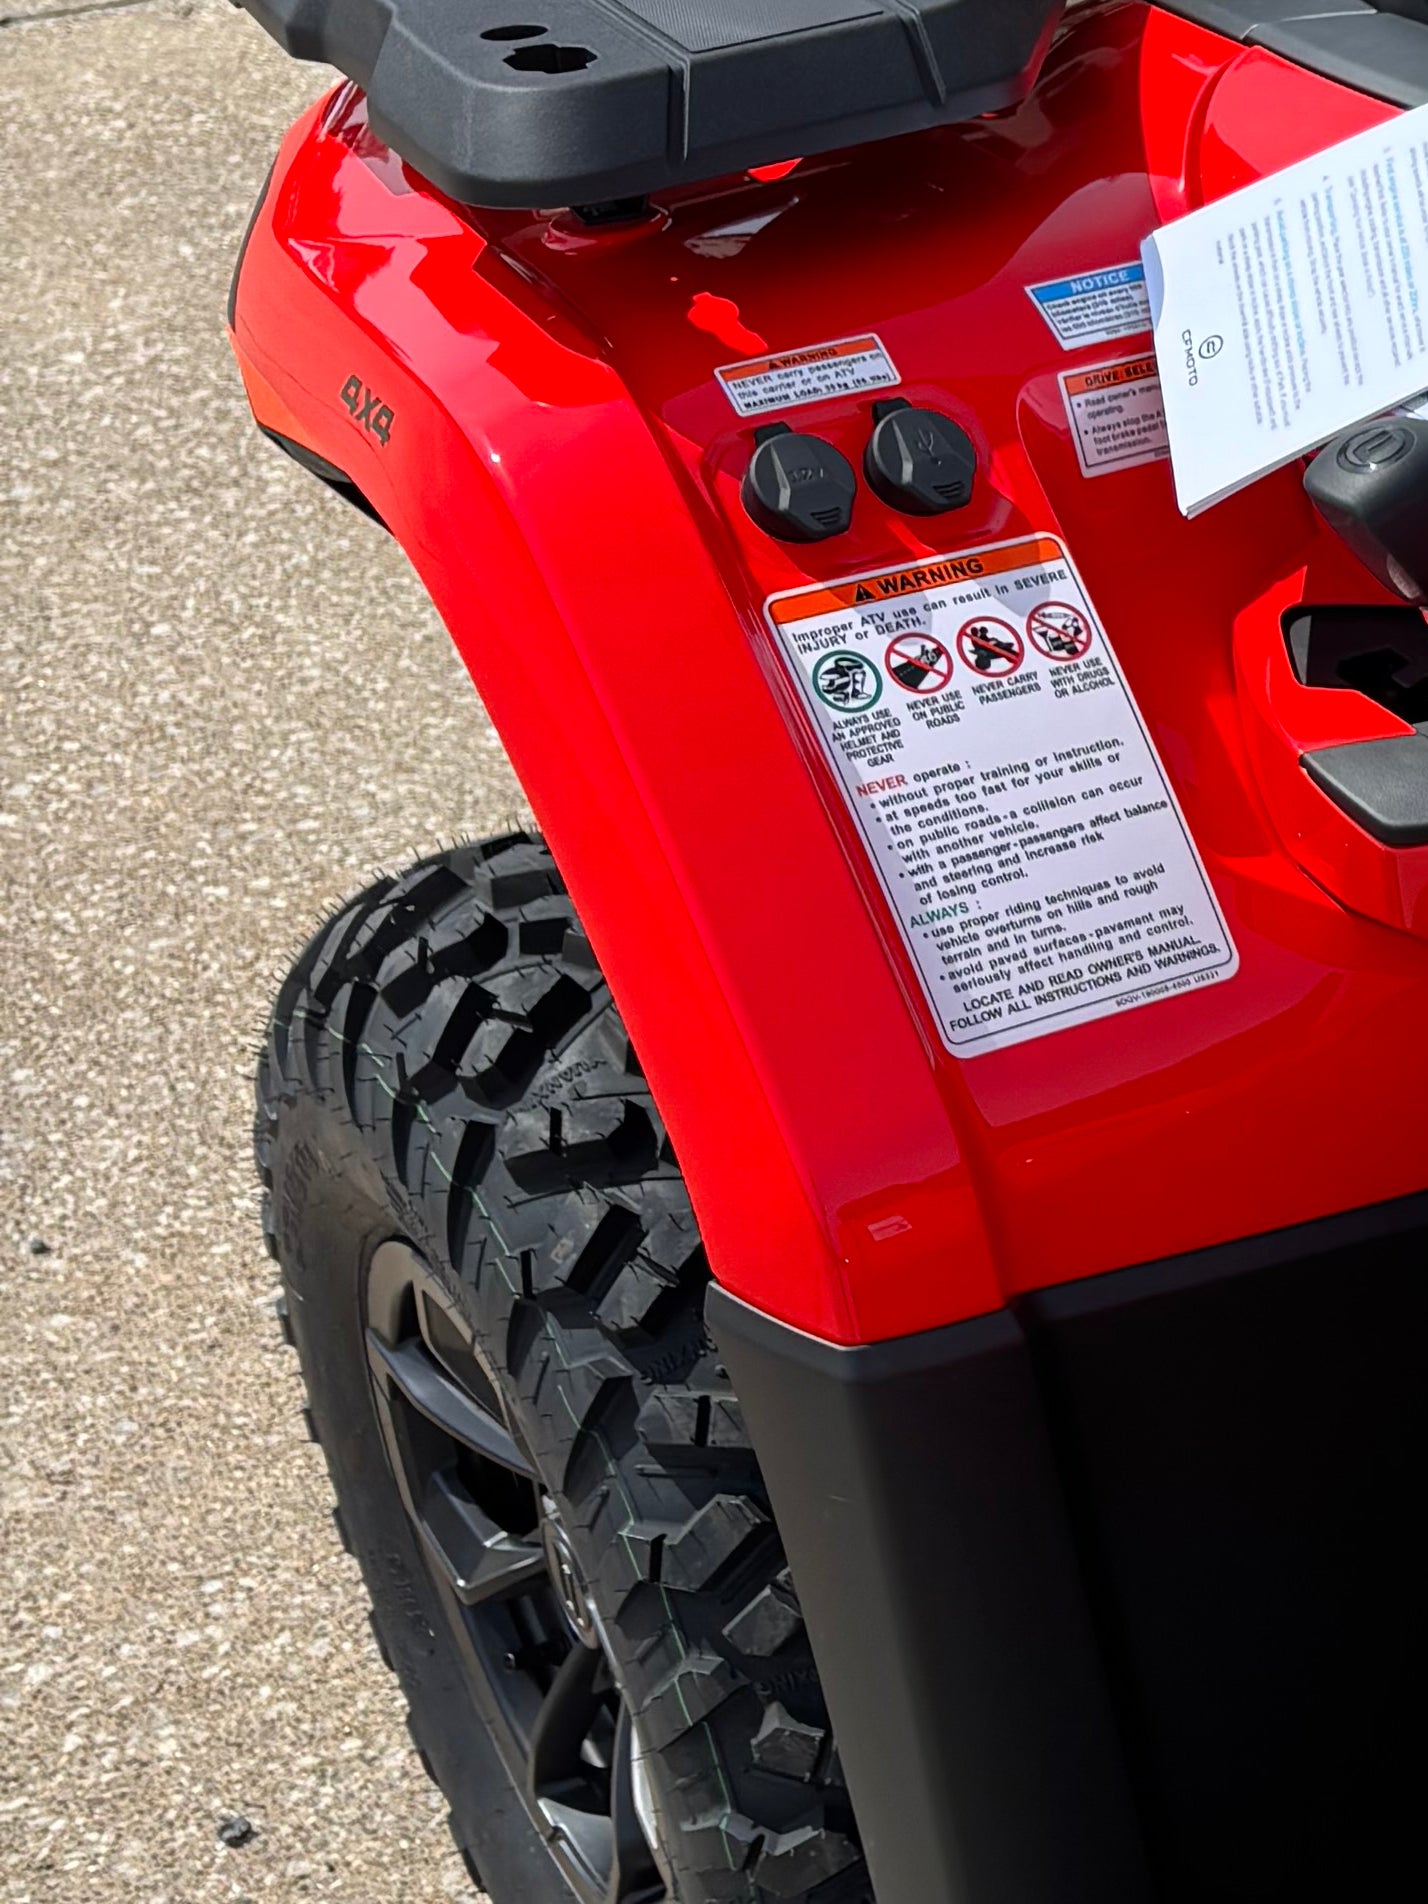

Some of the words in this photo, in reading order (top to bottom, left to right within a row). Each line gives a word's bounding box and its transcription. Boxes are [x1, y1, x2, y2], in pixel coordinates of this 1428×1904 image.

[1067, 269, 1131, 293] NOTICE
[731, 374, 772, 390] NEVER
[775, 367, 805, 381] carry
[806, 353, 868, 375] passengers
[779, 347, 838, 367] WARNING
[1182, 329, 1198, 386] CFMOTO
[1083, 369, 1119, 386] DRIVE
[877, 556, 985, 596] WARNING
[791, 619, 856, 645] Improper
[858, 611, 888, 629] ATV
[891, 604, 918, 621] use
[921, 596, 948, 614] can
[951, 586, 992, 606] result
[1012, 567, 1068, 591] SEVERE
[796, 633, 849, 656] INJURY
[874, 614, 927, 637] DEATH.
[971, 679, 1006, 696] NEVER
[1005, 670, 1040, 687] CARRY
[1048, 661, 1081, 678] NEVER
[1081, 655, 1103, 669] USE
[1049, 674, 1076, 689] WITH
[1075, 665, 1110, 682] DRUGS
[1070, 675, 1115, 695] ALCOHOL
[905, 695, 941, 712] NEVER
[940, 689, 963, 703] USE
[928, 700, 966, 717] PUBLIC
[978, 681, 1042, 706] PASSENGERS
[830, 713, 870, 731] ALWAYS
[870, 707, 893, 721] USE
[849, 716, 902, 738] APPROVED
[925, 712, 961, 730] ROADS
[839, 734, 879, 752] HELMET
[879, 728, 902, 742] AND
[845, 739, 904, 762] PROTECTIVE
[866, 753, 895, 768] GEAR
[877, 786, 929, 809] without
[932, 774, 977, 796] proper
[979, 759, 1031, 783] training
[1051, 734, 1125, 763] instruction.
[854, 773, 908, 798] NEVER
[911, 762, 962, 785] operate
[901, 795, 952, 820] speeds
[954, 789, 978, 804] too
[980, 781, 1008, 797] fast
[1010, 774, 1032, 789] for
[1034, 766, 1066, 784] your
[1067, 755, 1103, 774] skills
[889, 821, 913, 837] the
[915, 800, 989, 829] conditions.
[918, 824, 961, 846] public
[1021, 792, 1077, 817] collision
[1079, 785, 1105, 801] can
[1107, 775, 1145, 793] occur
[900, 847, 931, 865] with
[934, 832, 987, 856] another
[988, 817, 1040, 841] vehicle.
[906, 862, 934, 878] with
[1087, 810, 1122, 829] affect
[1123, 797, 1169, 819] balance
[912, 876, 938, 892] and
[940, 860, 994, 886] steering
[995, 853, 1021, 869] and
[1023, 837, 1078, 861] increase
[1079, 829, 1105, 846] risk
[929, 923, 955, 938] use
[957, 909, 1002, 932] proper
[1003, 897, 1042, 919] riding
[1043, 877, 1112, 908] techniques
[1131, 861, 1166, 881] avoid
[936, 880, 978, 903] losing
[979, 866, 1029, 889] control.
[907, 901, 970, 929] ALWAYS
[934, 930, 981, 953] vehicle
[983, 912, 1043, 938] overturns
[1065, 897, 1093, 914] hills
[1095, 889, 1120, 906] and
[1122, 879, 1159, 900] rough
[940, 945, 983, 966] terrain
[984, 936, 1010, 953] and
[1029, 920, 1067, 940] turns.
[946, 961, 984, 981] avoid
[987, 948, 1029, 970] paved
[1157, 903, 1186, 921] may
[951, 967, 1013, 996] seriously
[1016, 955, 1054, 975] affect
[1057, 937, 1114, 964] handling
[1116, 929, 1142, 945] and
[1144, 913, 1194, 937] control.
[948, 1006, 1005, 1032] FOLLOW
[1004, 997, 1032, 1015] ALL
[1033, 970, 1123, 1007] INSTRUCTIONS
[1123, 961, 1152, 979] AND
[1153, 940, 1221, 970] WARNINGS.
[962, 988, 1015, 1013] LOCATE
[1015, 979, 1045, 997] AND
[1047, 967, 1084, 987] READ
[1086, 949, 1145, 975] OWNER'S
[1146, 932, 1201, 957] MANUAL.
